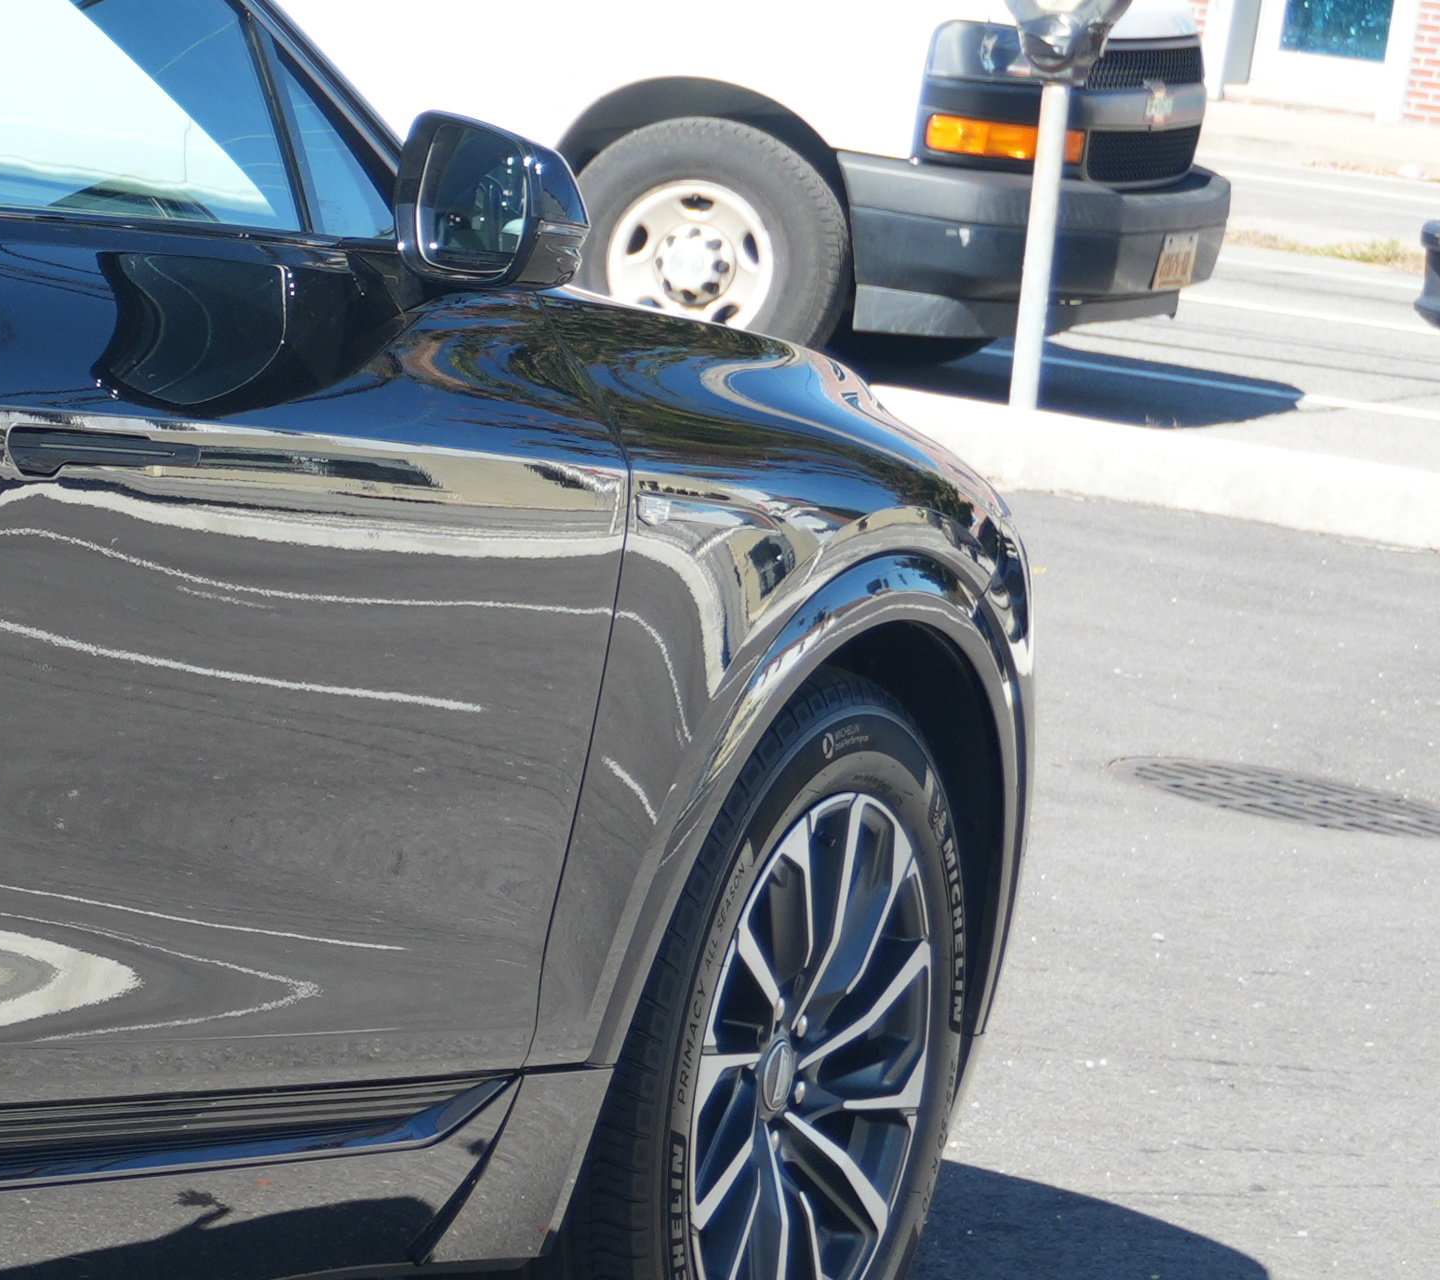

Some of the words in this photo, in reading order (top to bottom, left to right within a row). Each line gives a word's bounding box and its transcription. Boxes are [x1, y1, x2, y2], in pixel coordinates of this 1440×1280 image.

[677, 979, 706, 1105] PRIMACY
[705, 939, 719, 973] ALL
[717, 861, 746, 933] SEASON
[942, 837, 964, 1023] MICHELIN
